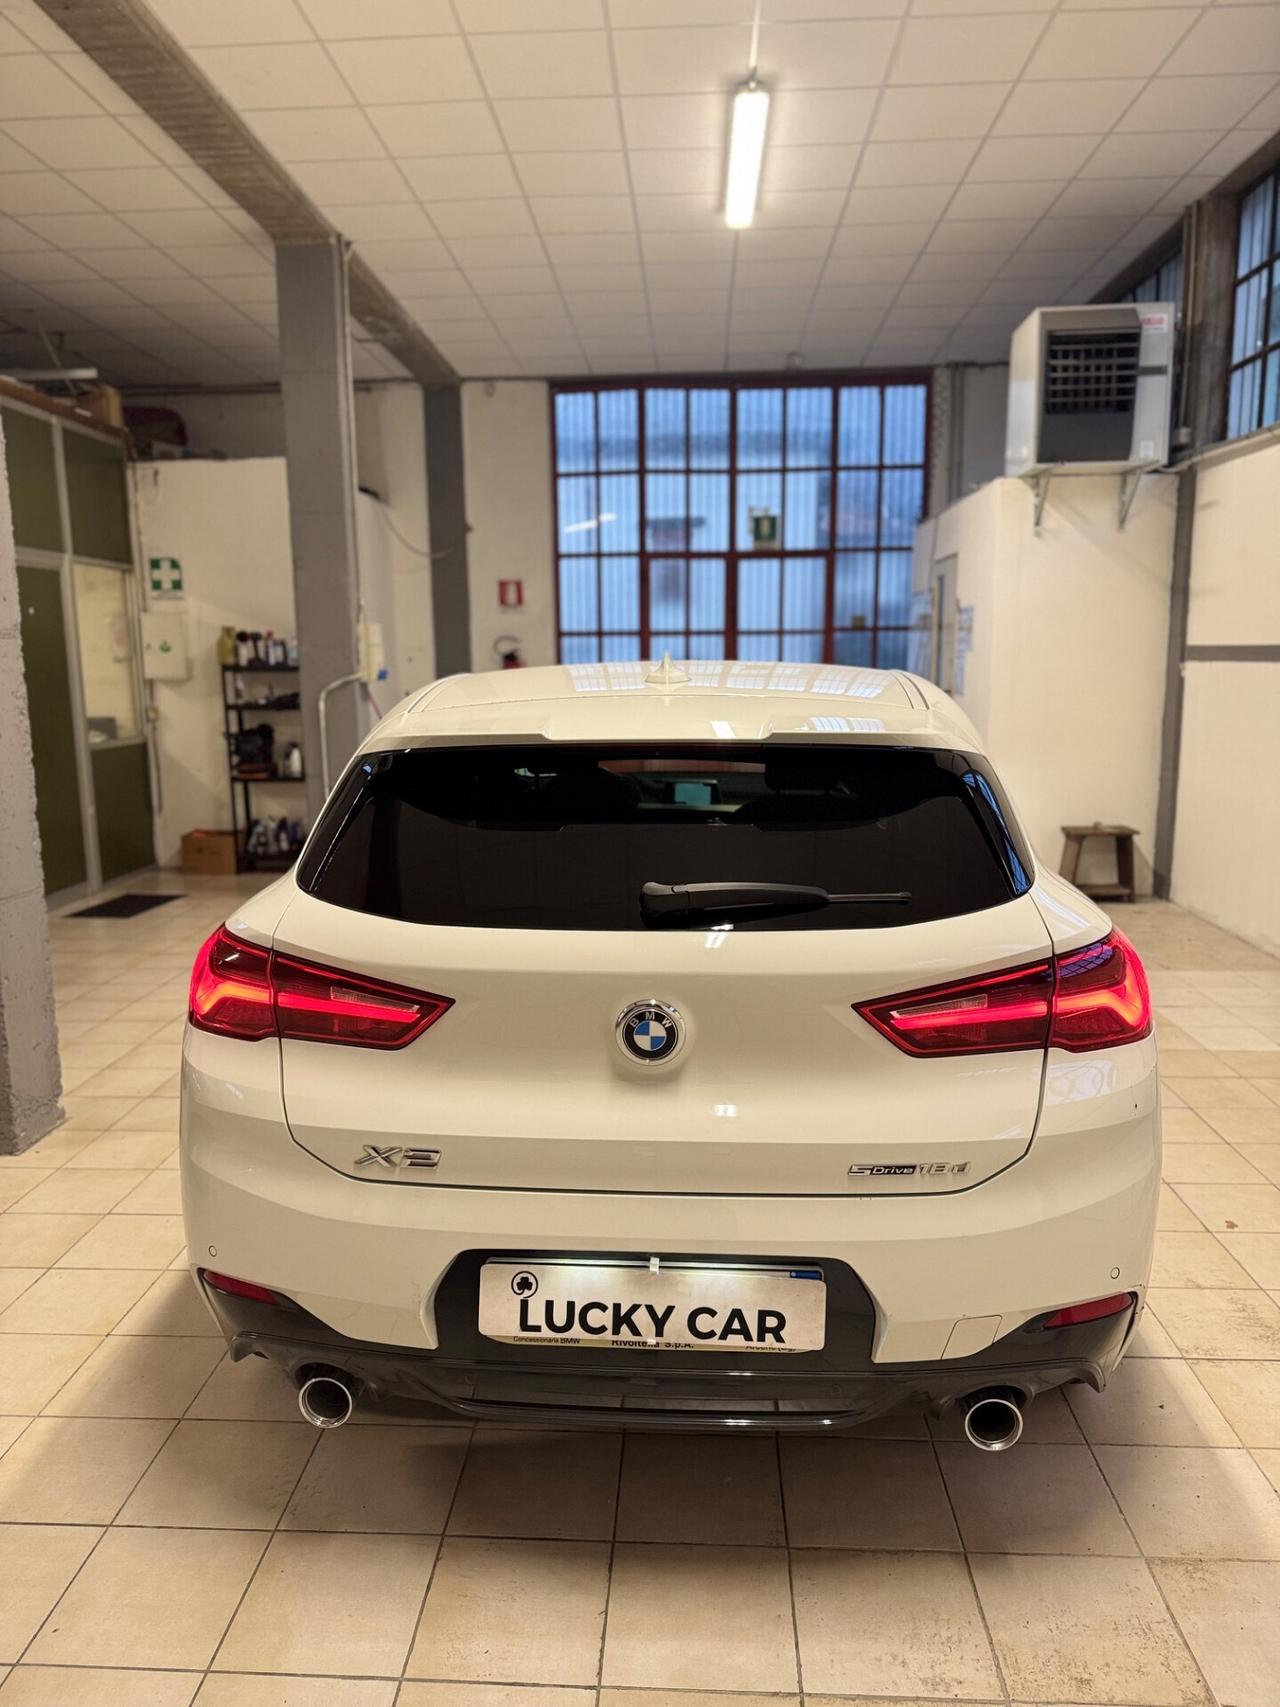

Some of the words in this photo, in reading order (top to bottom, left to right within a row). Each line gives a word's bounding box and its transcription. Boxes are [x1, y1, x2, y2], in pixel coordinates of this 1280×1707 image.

[629, 1011, 672, 1028] BMW
[353, 1144, 442, 1169] X2
[519, 1298, 676, 1338] LUCKY
[687, 1306, 787, 1344] CAR
